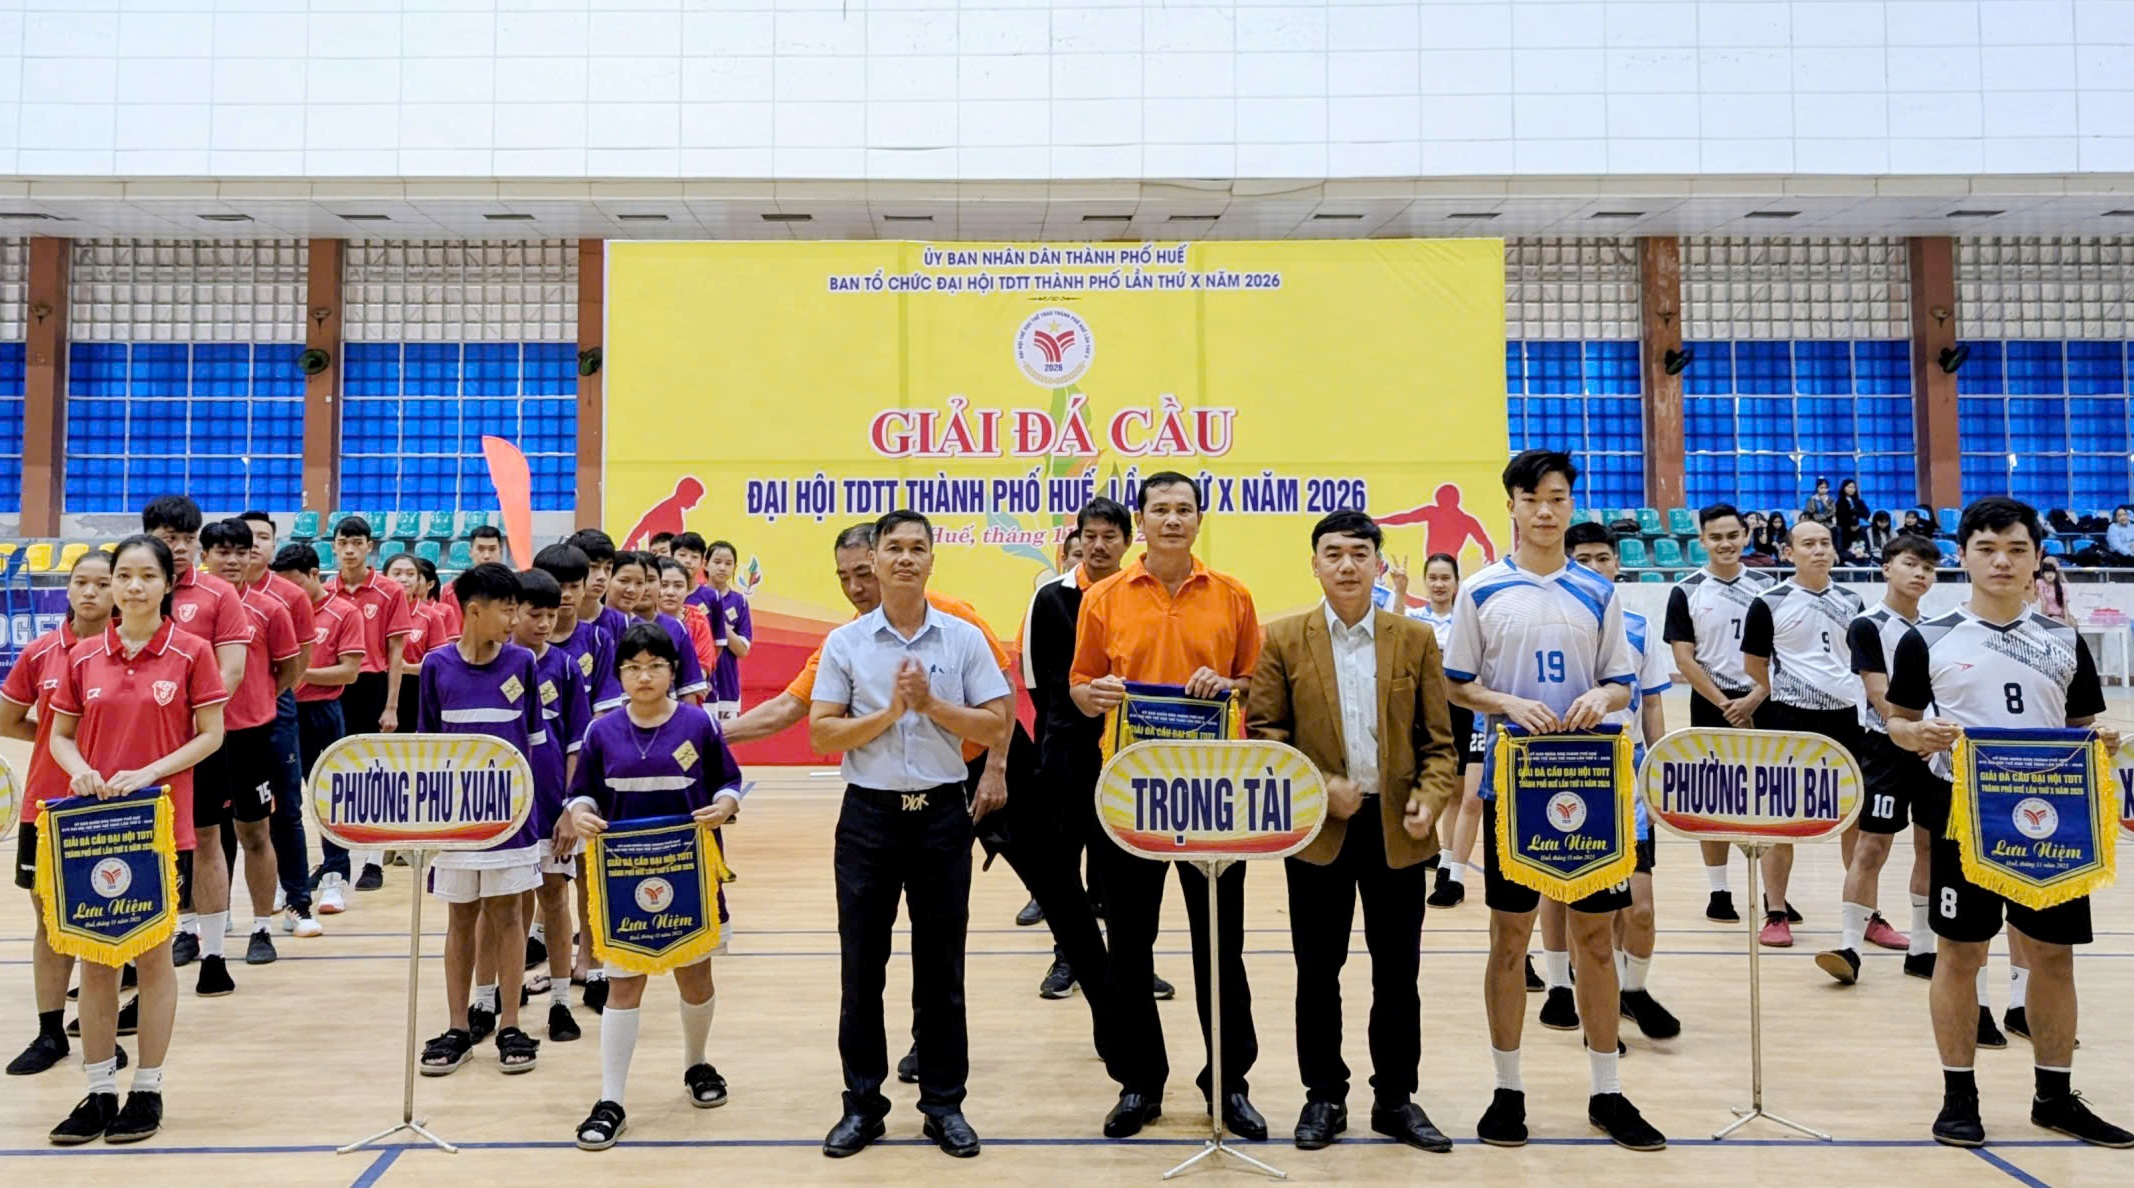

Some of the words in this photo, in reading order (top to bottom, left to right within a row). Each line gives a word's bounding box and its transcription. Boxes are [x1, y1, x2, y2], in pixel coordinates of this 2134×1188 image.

[924, 248, 942, 265] ỦY
[950, 252, 977, 265] BAN
[983, 248, 1024, 265] NHÂN
[1030, 248, 1060, 265] DÂN
[1066, 247, 1115, 264] THÀNH
[1120, 244, 1152, 263] PHỐ
[1156, 244, 1187, 264] HUẾ
[830, 277, 859, 290] BAN
[865, 269, 883, 290] TỔ
[889, 273, 932, 290] CHỨC
[937, 277, 961, 294] ĐẠI
[968, 273, 993, 294] HỘI
[1000, 276, 1030, 290] TDTT
[1034, 272, 1084, 289] THÀNH
[1089, 269, 1121, 288] PHỐ
[1126, 268, 1153, 288] LẦN
[1158, 270, 1186, 288] THỨ
[1191, 275, 1201, 288] X
[1206, 271, 1240, 288] NĂM
[1245, 274, 1280, 288] 2026
[871, 396, 1001, 457] GIẢI
[1011, 395, 1098, 457] ĐÁ
[1109, 396, 1235, 457] CẦU
[748, 480, 787, 521] ĐẠI
[796, 473, 835, 521] HỘI
[843, 480, 898, 513] TDTT
[905, 473, 985, 513] THÀNH
[993, 466, 1043, 513] PHỐ
[1049, 468, 1093, 513] HUẾ
[1218, 480, 1234, 512] X
[1242, 471, 1297, 512] NĂM
[1307, 479, 1366, 512] 2026
[983, 526, 1047, 546] tháng
[1731, 618, 1741, 640] 7
[1821, 631, 1831, 653] 9
[1536, 650, 1566, 683] 19
[2003, 682, 2024, 714] 8
[256, 780, 272, 805] 15
[331, 759, 409, 824] PHƯỜNG
[415, 760, 454, 823] PHÚ
[459, 759, 511, 822] XUÂN
[1663, 751, 1747, 815] PHƯỜNG
[1755, 756, 1796, 818] PHÚ
[1804, 757, 1838, 819] BÀI
[1131, 777, 1234, 844] TRỌNG
[1243, 766, 1291, 831] TÀI
[1872, 794, 1895, 819] 10
[1526, 834, 1560, 851] Lưu
[1564, 834, 1608, 854] Niệm
[1991, 840, 2028, 857] Lưu
[2033, 841, 2083, 861] Niệm
[72, 902, 104, 920] Lưu
[108, 899, 155, 917] Niệm
[1940, 886, 1957, 919] 8
[616, 917, 648, 933] Lưu
[652, 914, 693, 931] Niệm
